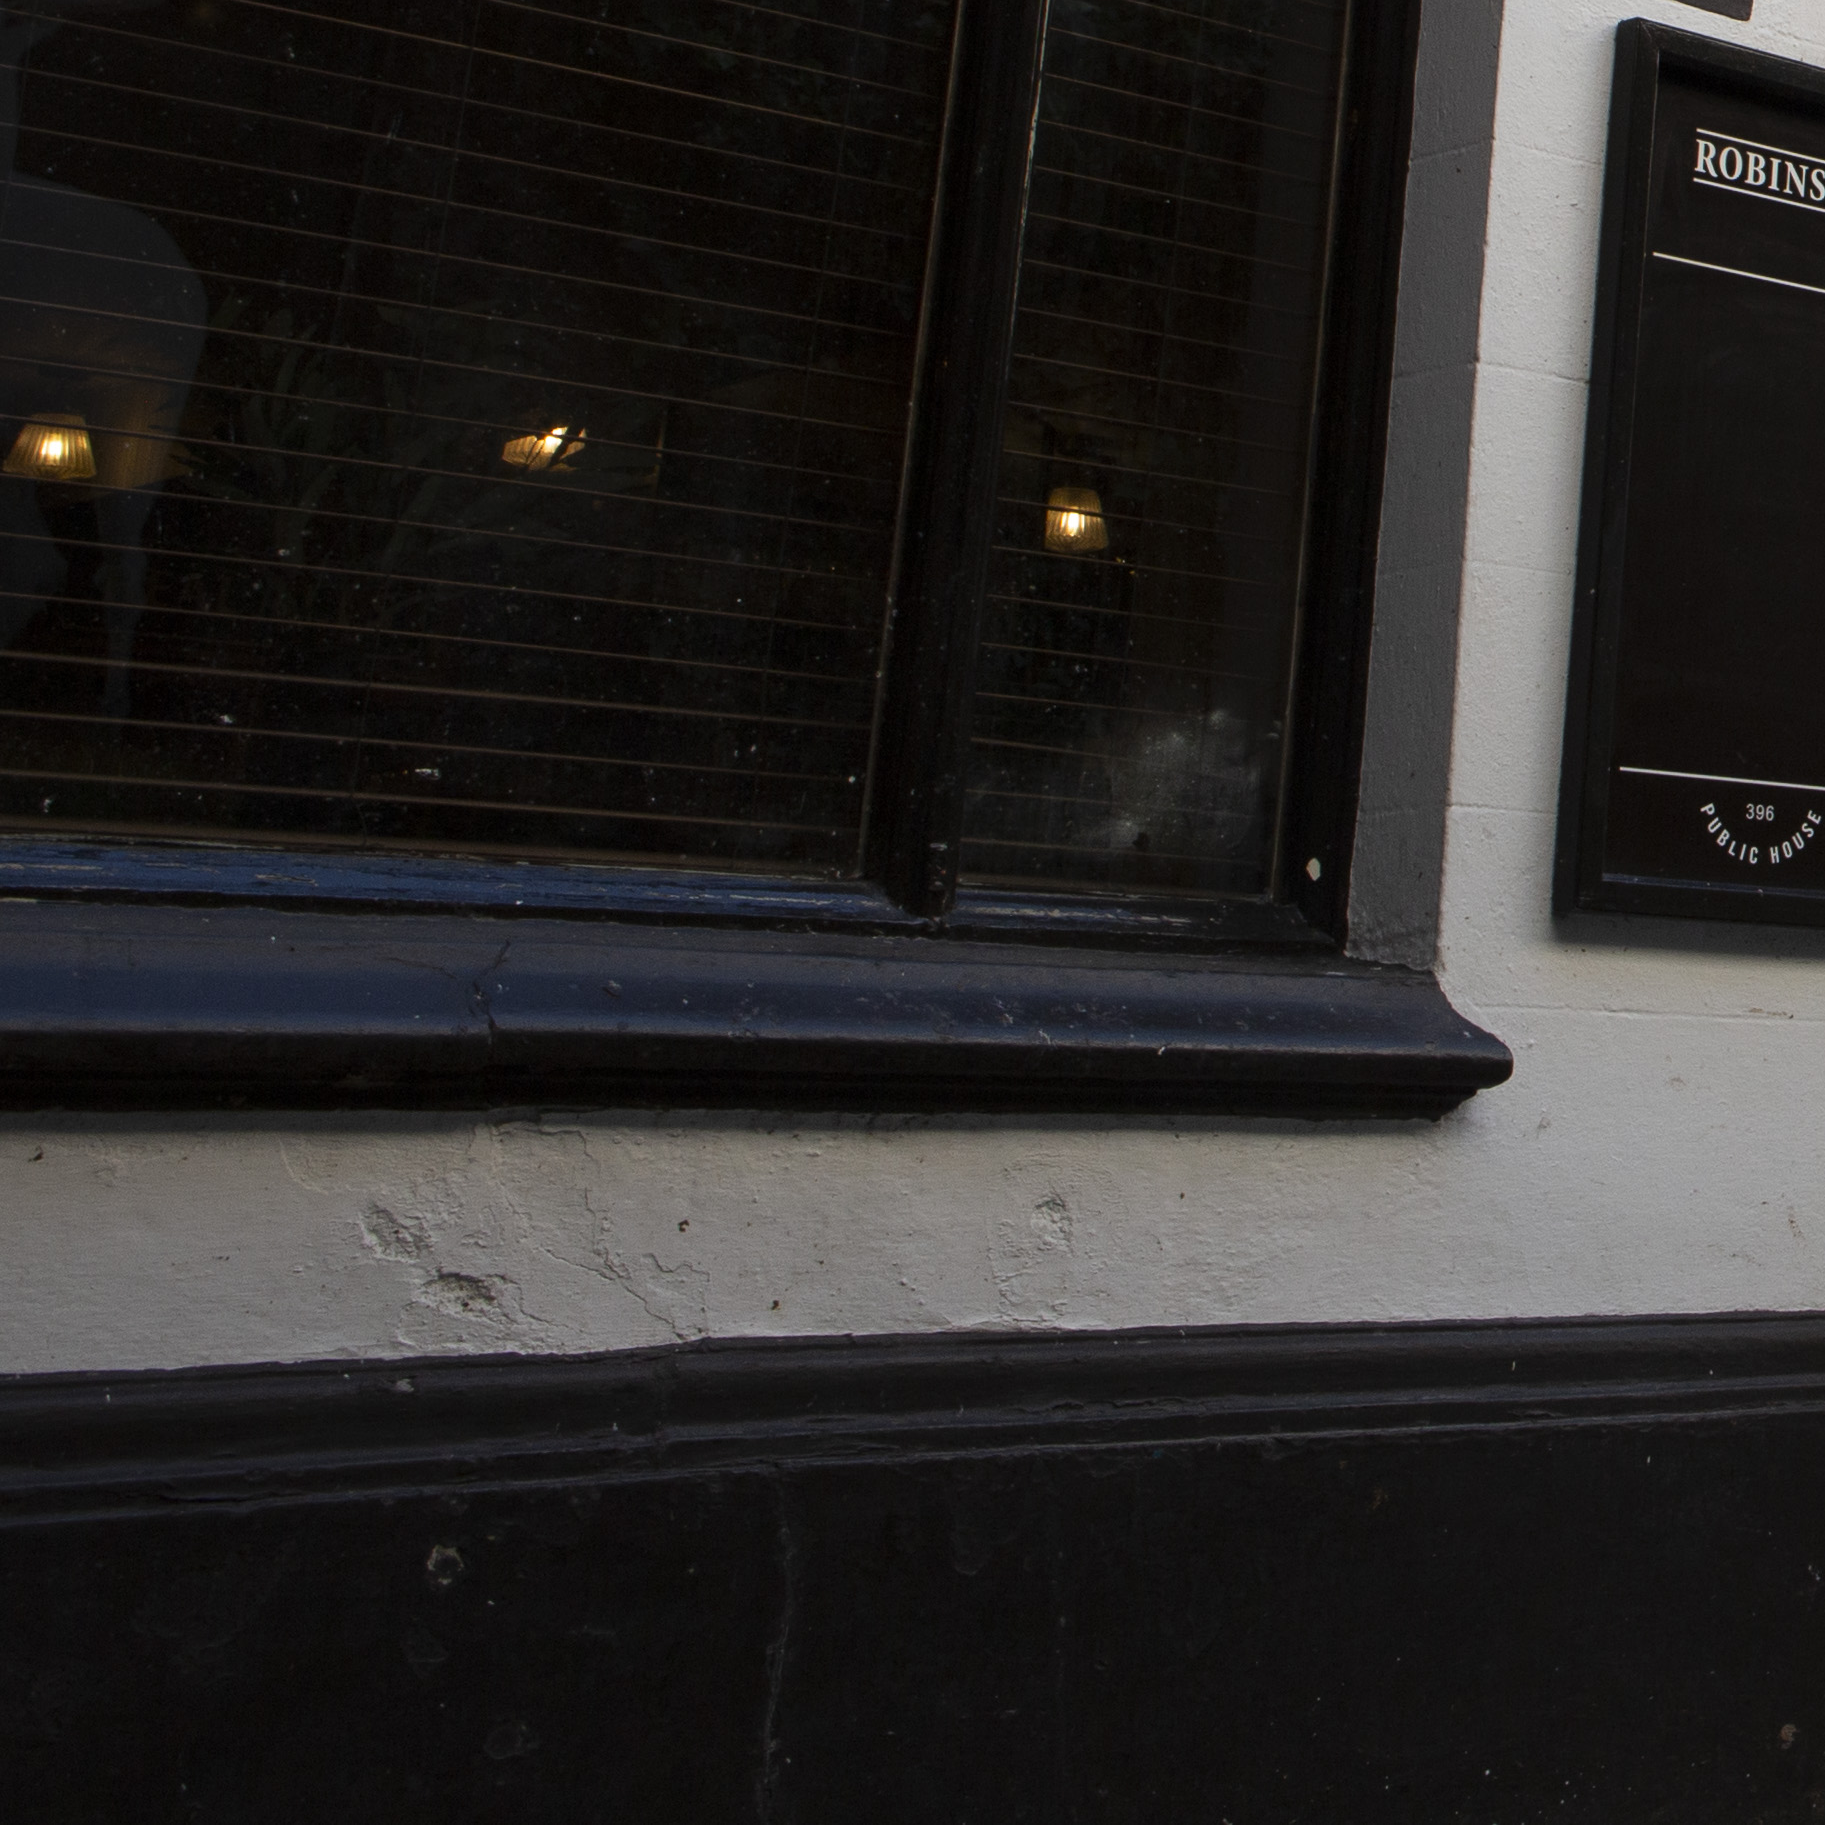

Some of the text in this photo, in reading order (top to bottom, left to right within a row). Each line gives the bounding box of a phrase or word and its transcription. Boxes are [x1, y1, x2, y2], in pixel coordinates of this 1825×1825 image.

[1745, 803, 1775, 822] 396
[1700, 802, 1823, 865] PUBLIC HOUSE
